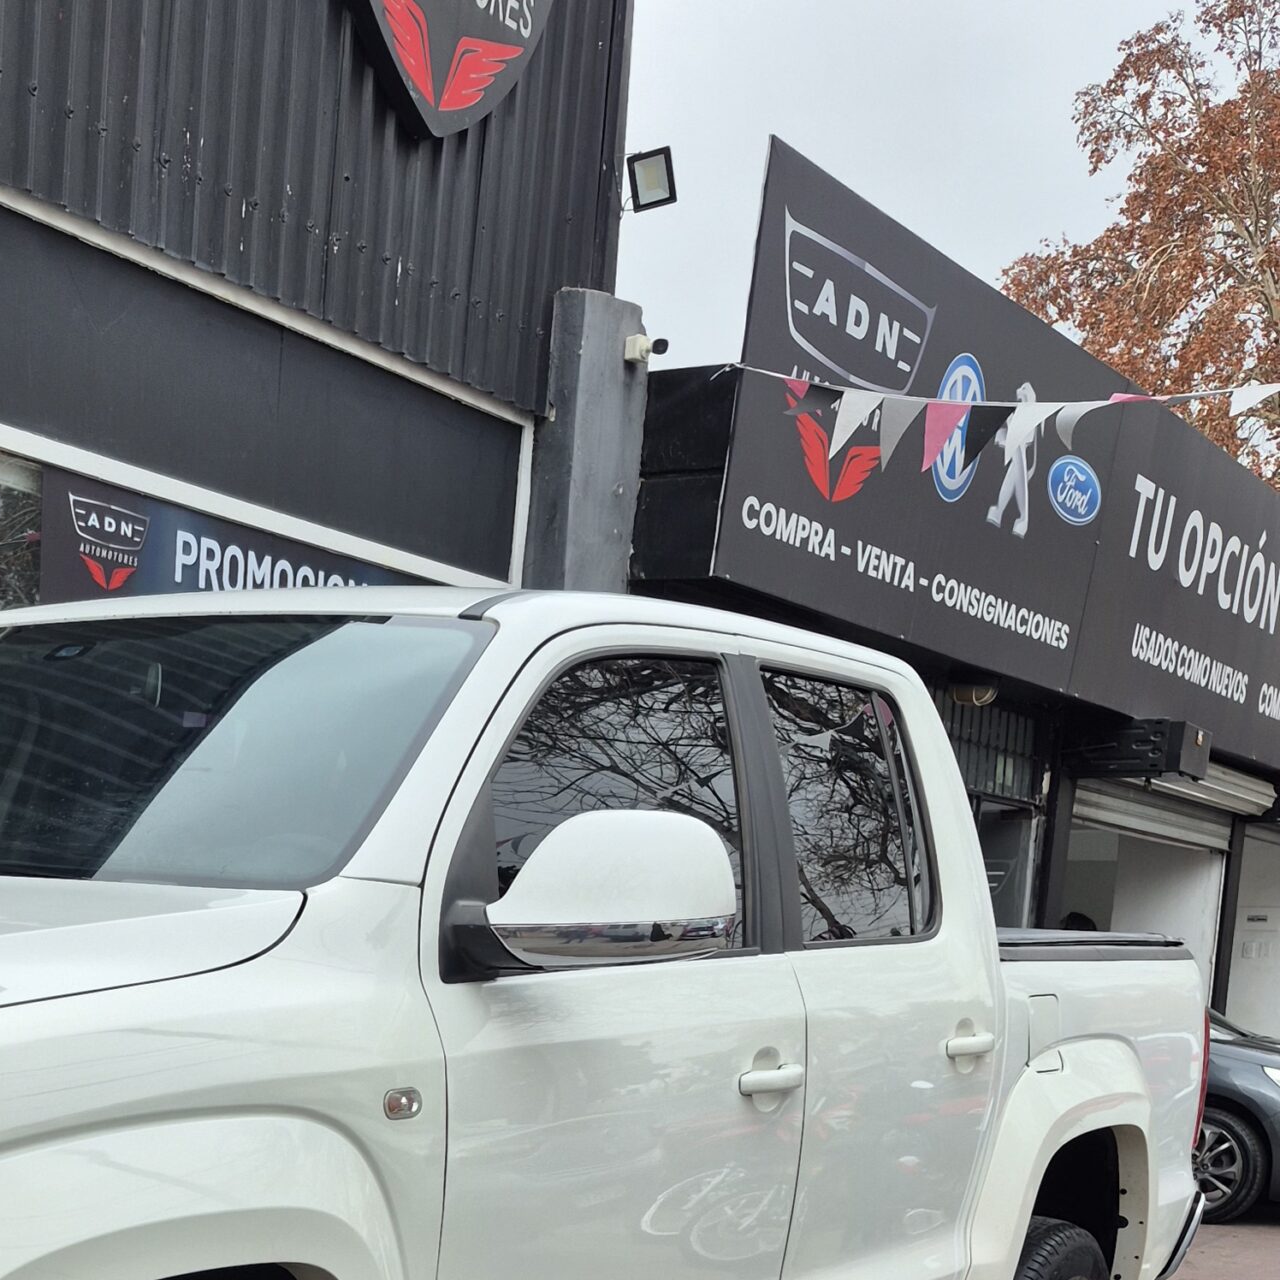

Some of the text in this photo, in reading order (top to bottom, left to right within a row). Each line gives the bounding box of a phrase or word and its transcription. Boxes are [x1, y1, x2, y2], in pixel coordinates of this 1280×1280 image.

[812, 278, 900, 360] ADN
[87, 512, 132, 538] ADN
[1056, 465, 1093, 514] Ford
[79, 542, 138, 567] AUTOMOTORES
[174, 529, 368, 592] PROMO
[742, 496, 836, 561] COMPRA
[857, 540, 915, 592] VENTA
[931, 573, 1070, 650] CONSIGNACIONES
[1129, 473, 1280, 635] TU OPCIÓN
[1131, 622, 1249, 704] USADOS COMO NUEVOS
